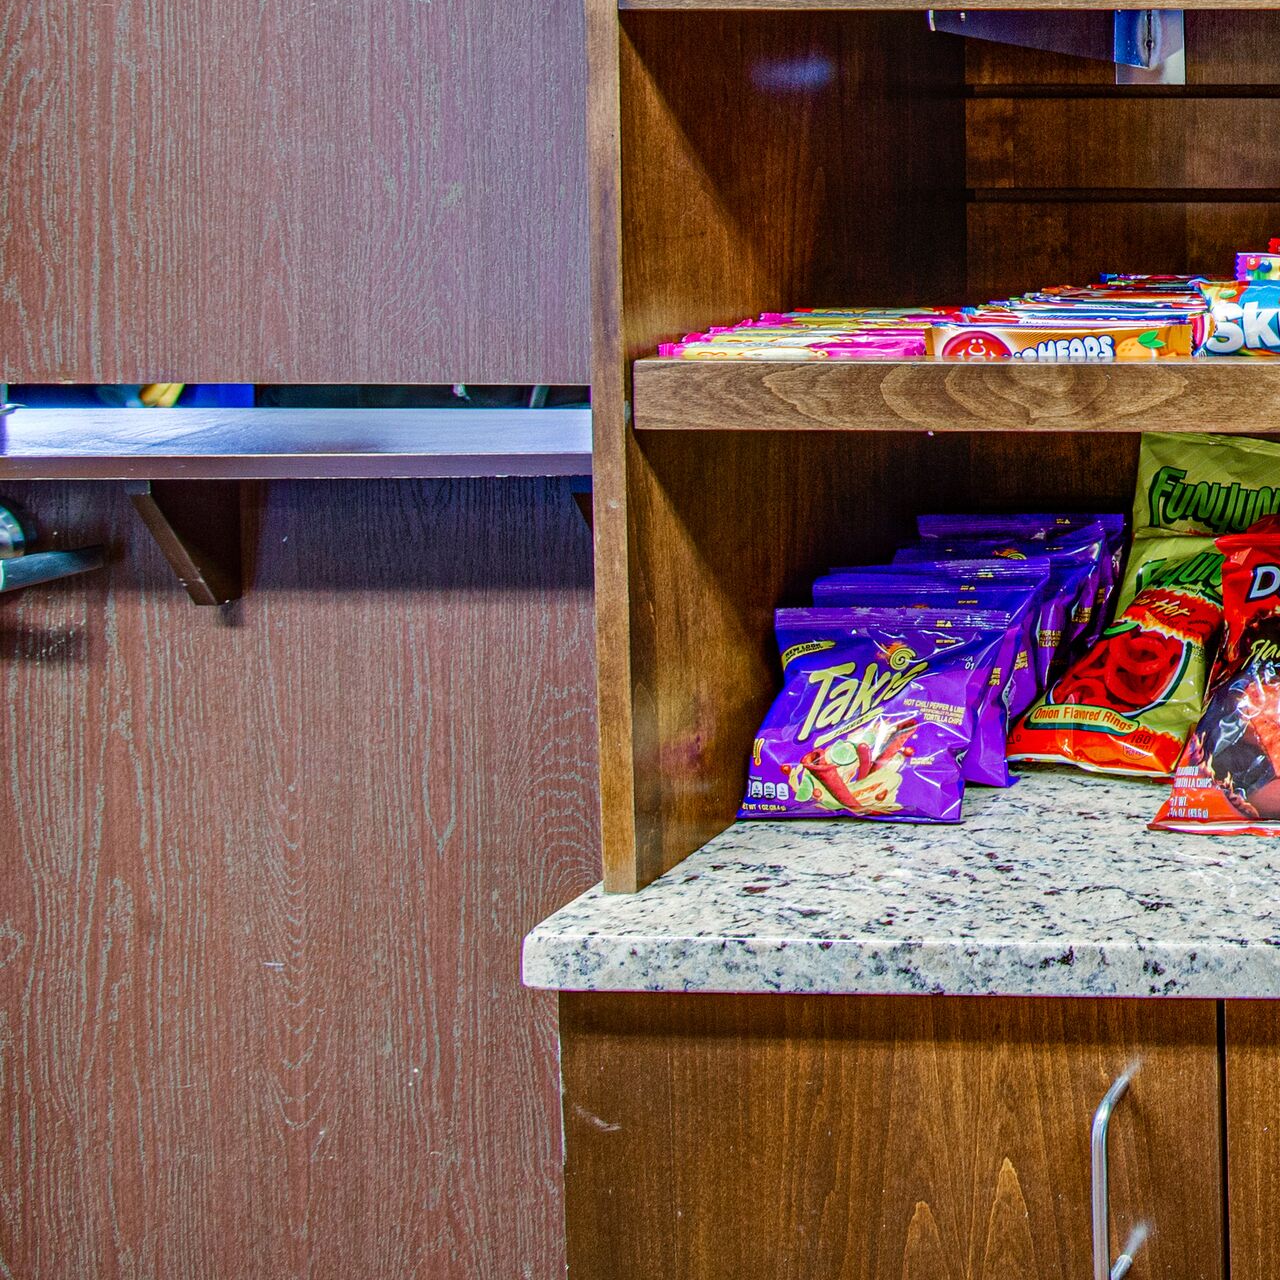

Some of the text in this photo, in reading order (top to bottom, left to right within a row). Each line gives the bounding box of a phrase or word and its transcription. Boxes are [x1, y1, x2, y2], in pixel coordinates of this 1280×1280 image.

[797, 661, 930, 742] Takis
[923, 713, 947, 722] TORTILLA
[947, 716, 963, 726] CHIPS
[1033, 705, 1136, 732] Onion Flavored Rings
